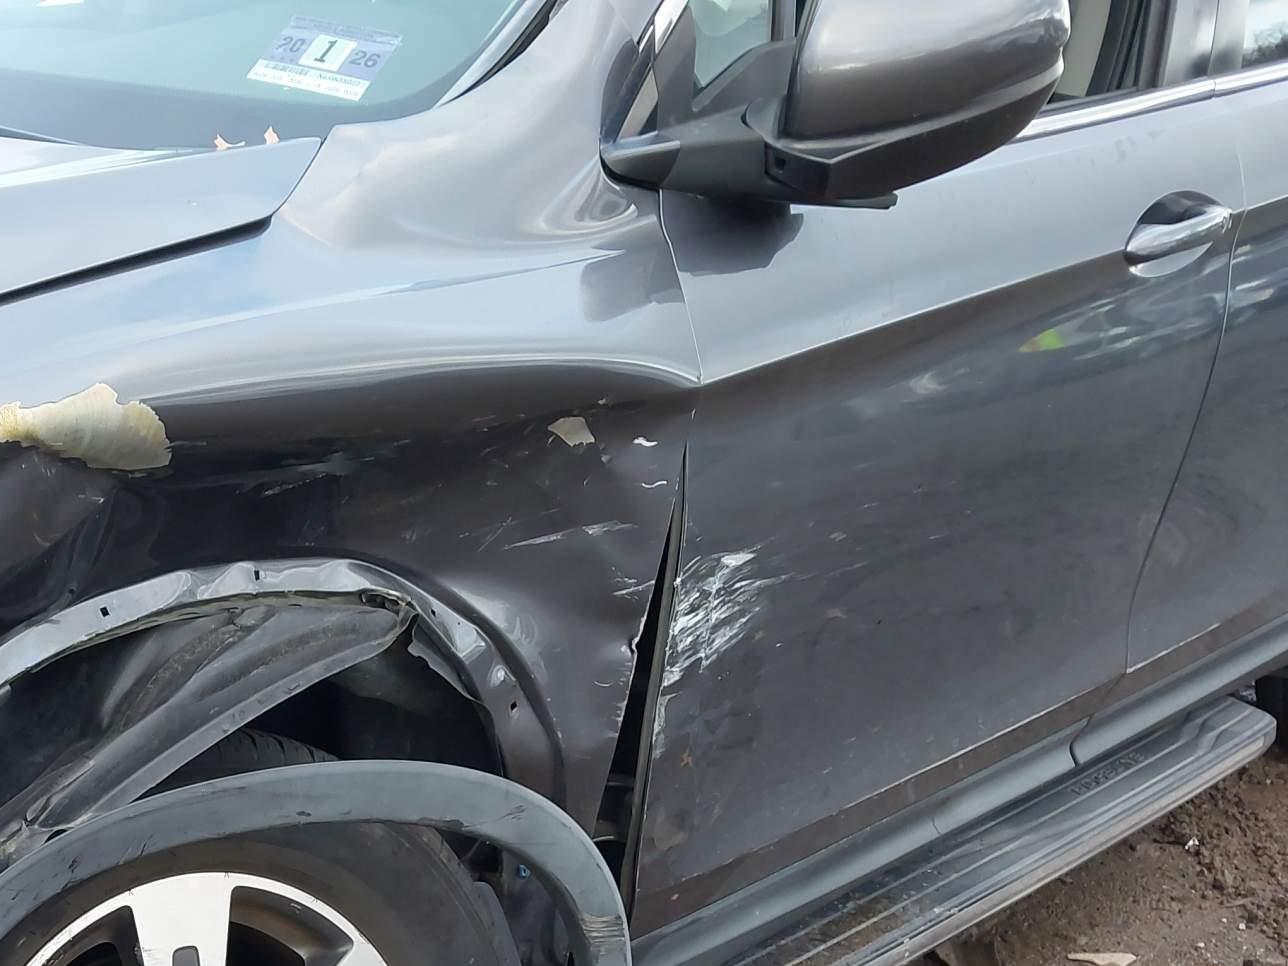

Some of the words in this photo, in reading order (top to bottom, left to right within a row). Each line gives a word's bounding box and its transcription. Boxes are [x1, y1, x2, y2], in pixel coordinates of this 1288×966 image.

[276, 36, 306, 53] 20
[313, 39, 339, 63] 1
[349, 51, 380, 69] 26
